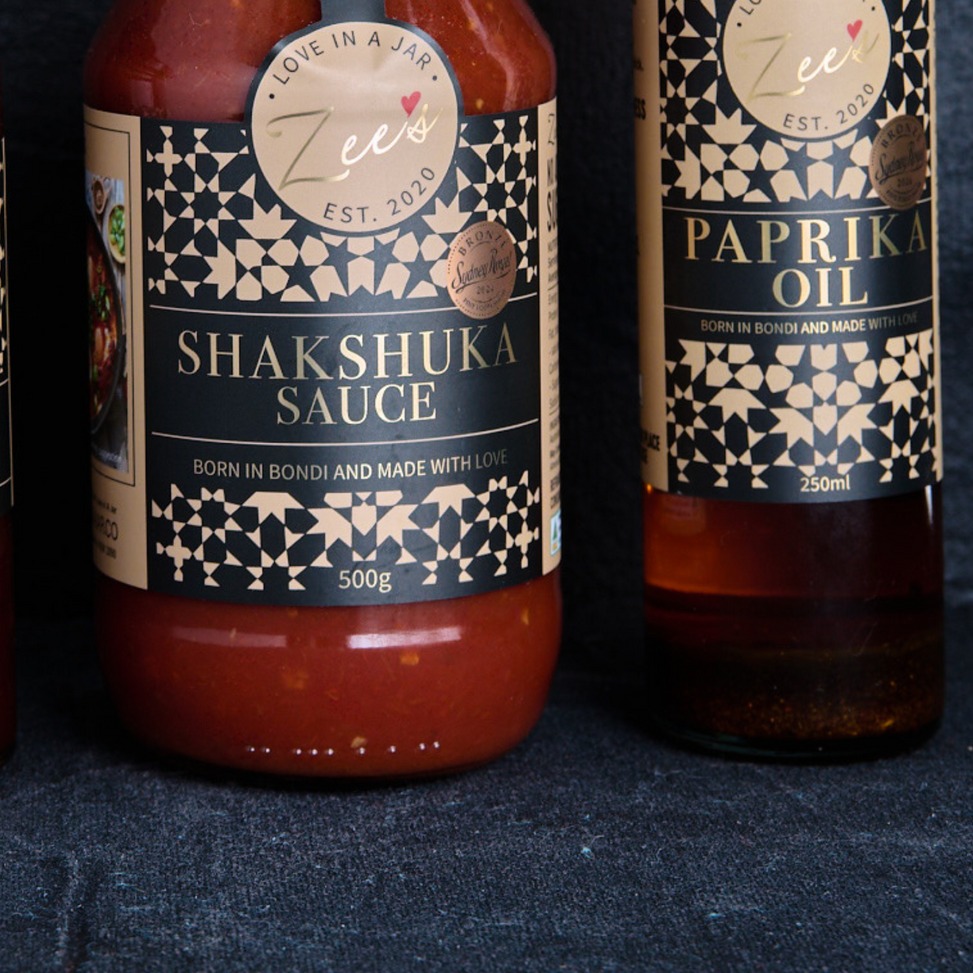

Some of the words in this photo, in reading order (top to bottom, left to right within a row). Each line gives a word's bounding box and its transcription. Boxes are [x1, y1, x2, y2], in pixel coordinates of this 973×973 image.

[272, 40, 325, 85] LOVE
[332, 30, 356, 49] IN
[368, 31, 381, 47] A
[391, 36, 432, 71] JAR
[783, 113, 828, 131] EST.
[836, 83, 874, 125] 2020
[323, 202, 377, 224] EST.
[387, 167, 435, 216] 2020
[684, 209, 927, 264] PAPRIKA
[772, 266, 869, 308] OIL
[701, 319, 734, 333] BORN
[737, 320, 751, 334] IN
[755, 321, 798, 335] BONDI
[801, 320, 829, 334] AND
[832, 319, 866, 333] MADE
[868, 316, 896, 331] WITH
[898, 311, 918, 326] LOVE
[178, 322, 518, 380] SHAKSHUKA
[277, 381, 437, 425] SAUCE
[193, 459, 240, 478] BORN
[245, 463, 263, 480] IN
[269, 464, 328, 481] BONDI
[333, 463, 373, 481] AND
[377, 460, 426, 479] MADE
[430, 455, 472, 475] WITH
[475, 448, 508, 469] LOVE
[800, 475, 851, 493] 250ml
[338, 569, 392, 593] 500g
